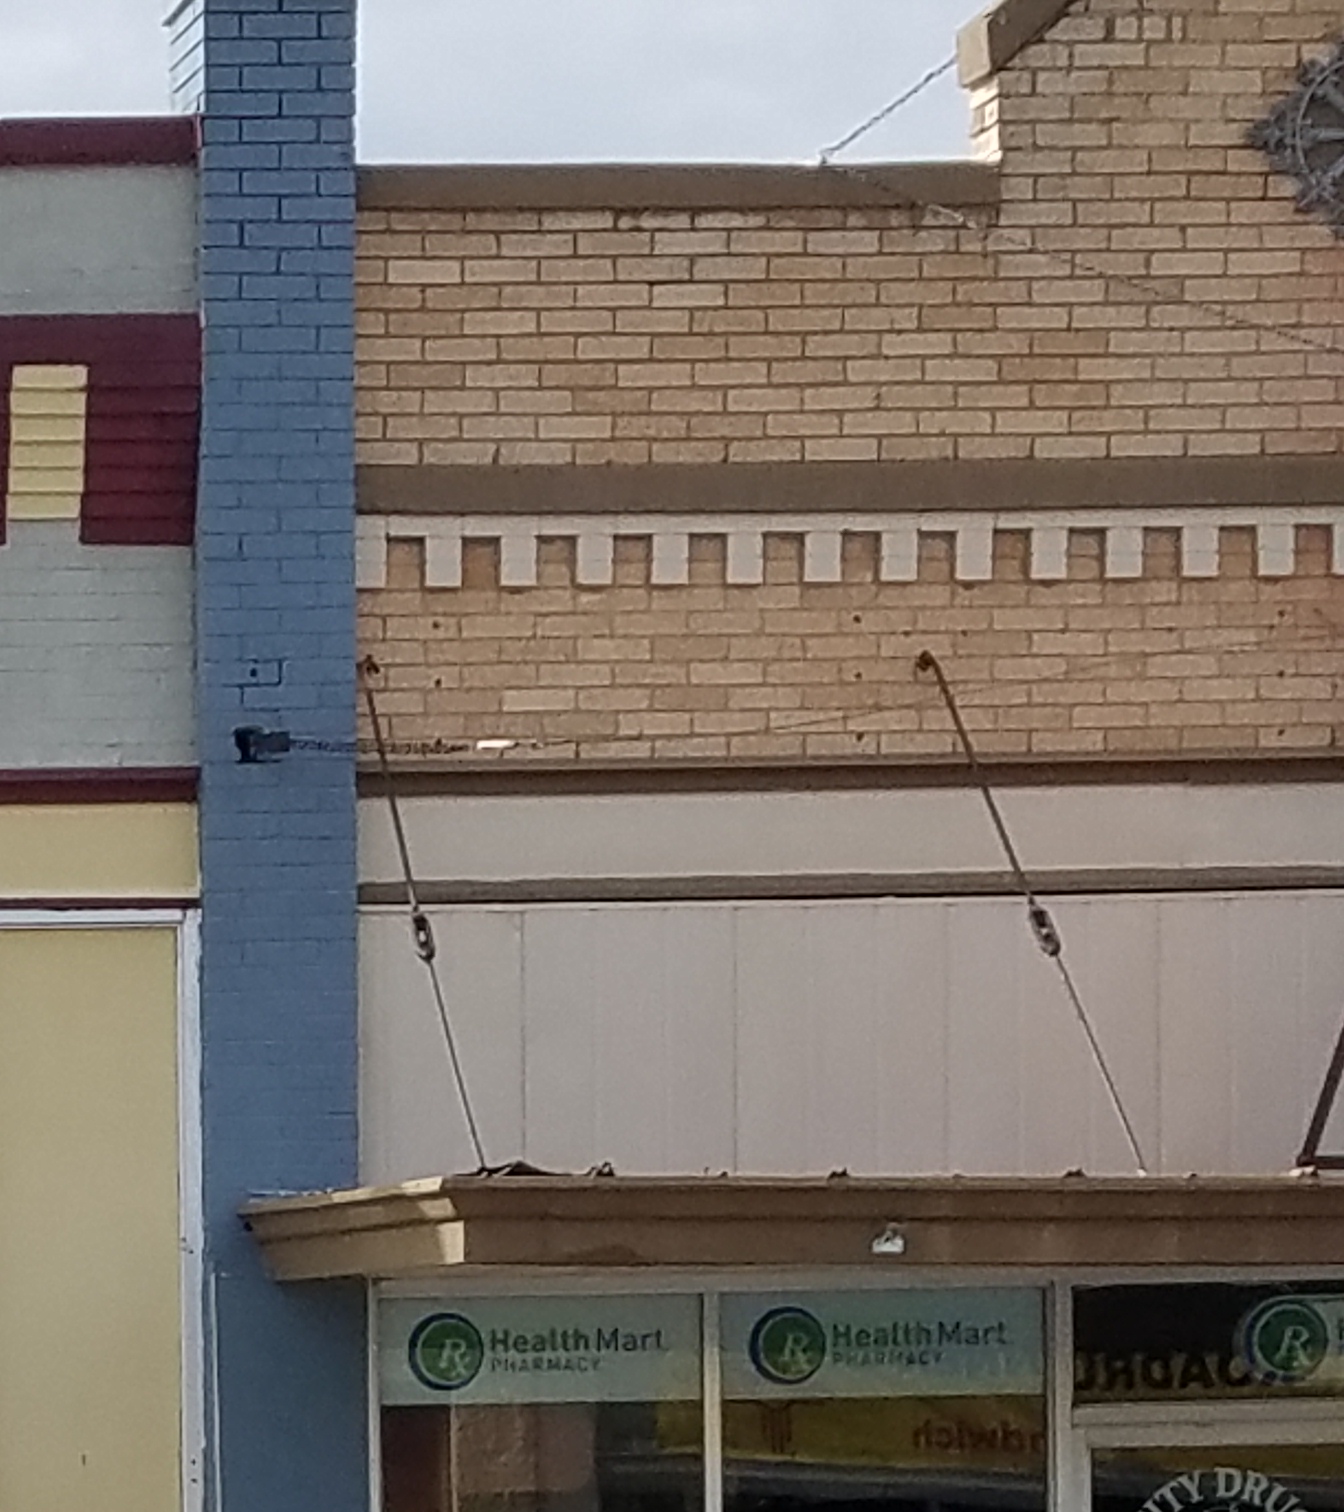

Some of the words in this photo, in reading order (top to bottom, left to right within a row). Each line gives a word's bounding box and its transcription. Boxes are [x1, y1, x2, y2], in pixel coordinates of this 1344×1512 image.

[490, 1327, 590, 1353] Health
[596, 1326, 664, 1353] Mart
[831, 1321, 933, 1348] Health
[937, 1320, 1007, 1347] Mart
[490, 1356, 602, 1373] PHARMACY
[831, 1351, 944, 1367] PHARMACY
